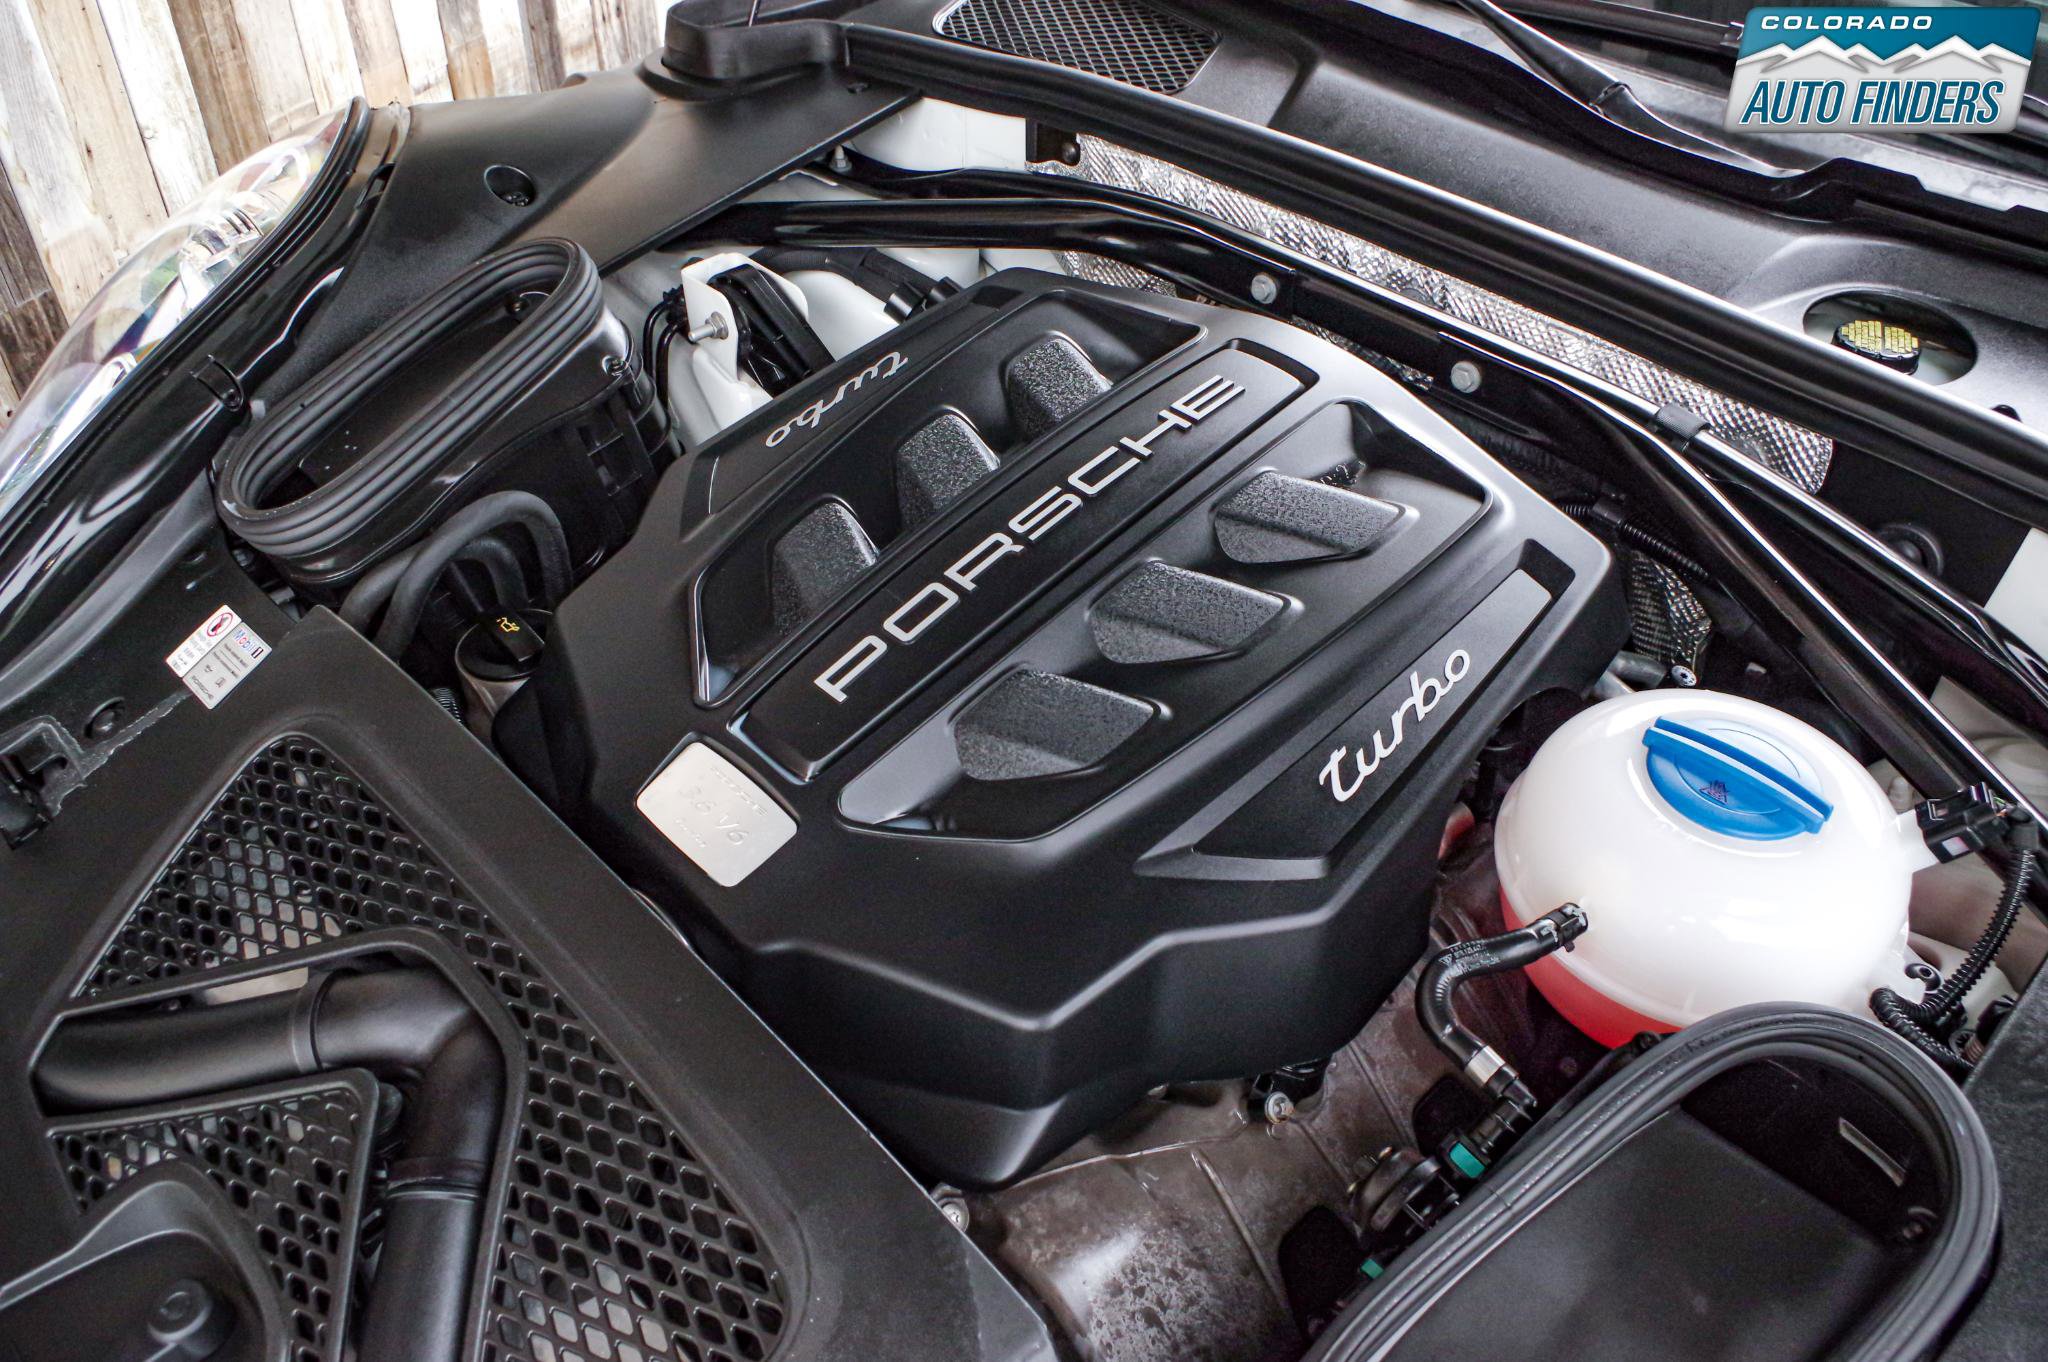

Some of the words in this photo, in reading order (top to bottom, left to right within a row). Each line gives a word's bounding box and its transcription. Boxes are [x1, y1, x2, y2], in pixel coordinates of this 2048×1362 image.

[764, 350, 909, 449] turbo
[814, 374, 1246, 703] PORSCHE
[234, 629, 257, 654] Mobil
[1319, 649, 1470, 802] turbo
[714, 812, 750, 847] V6
